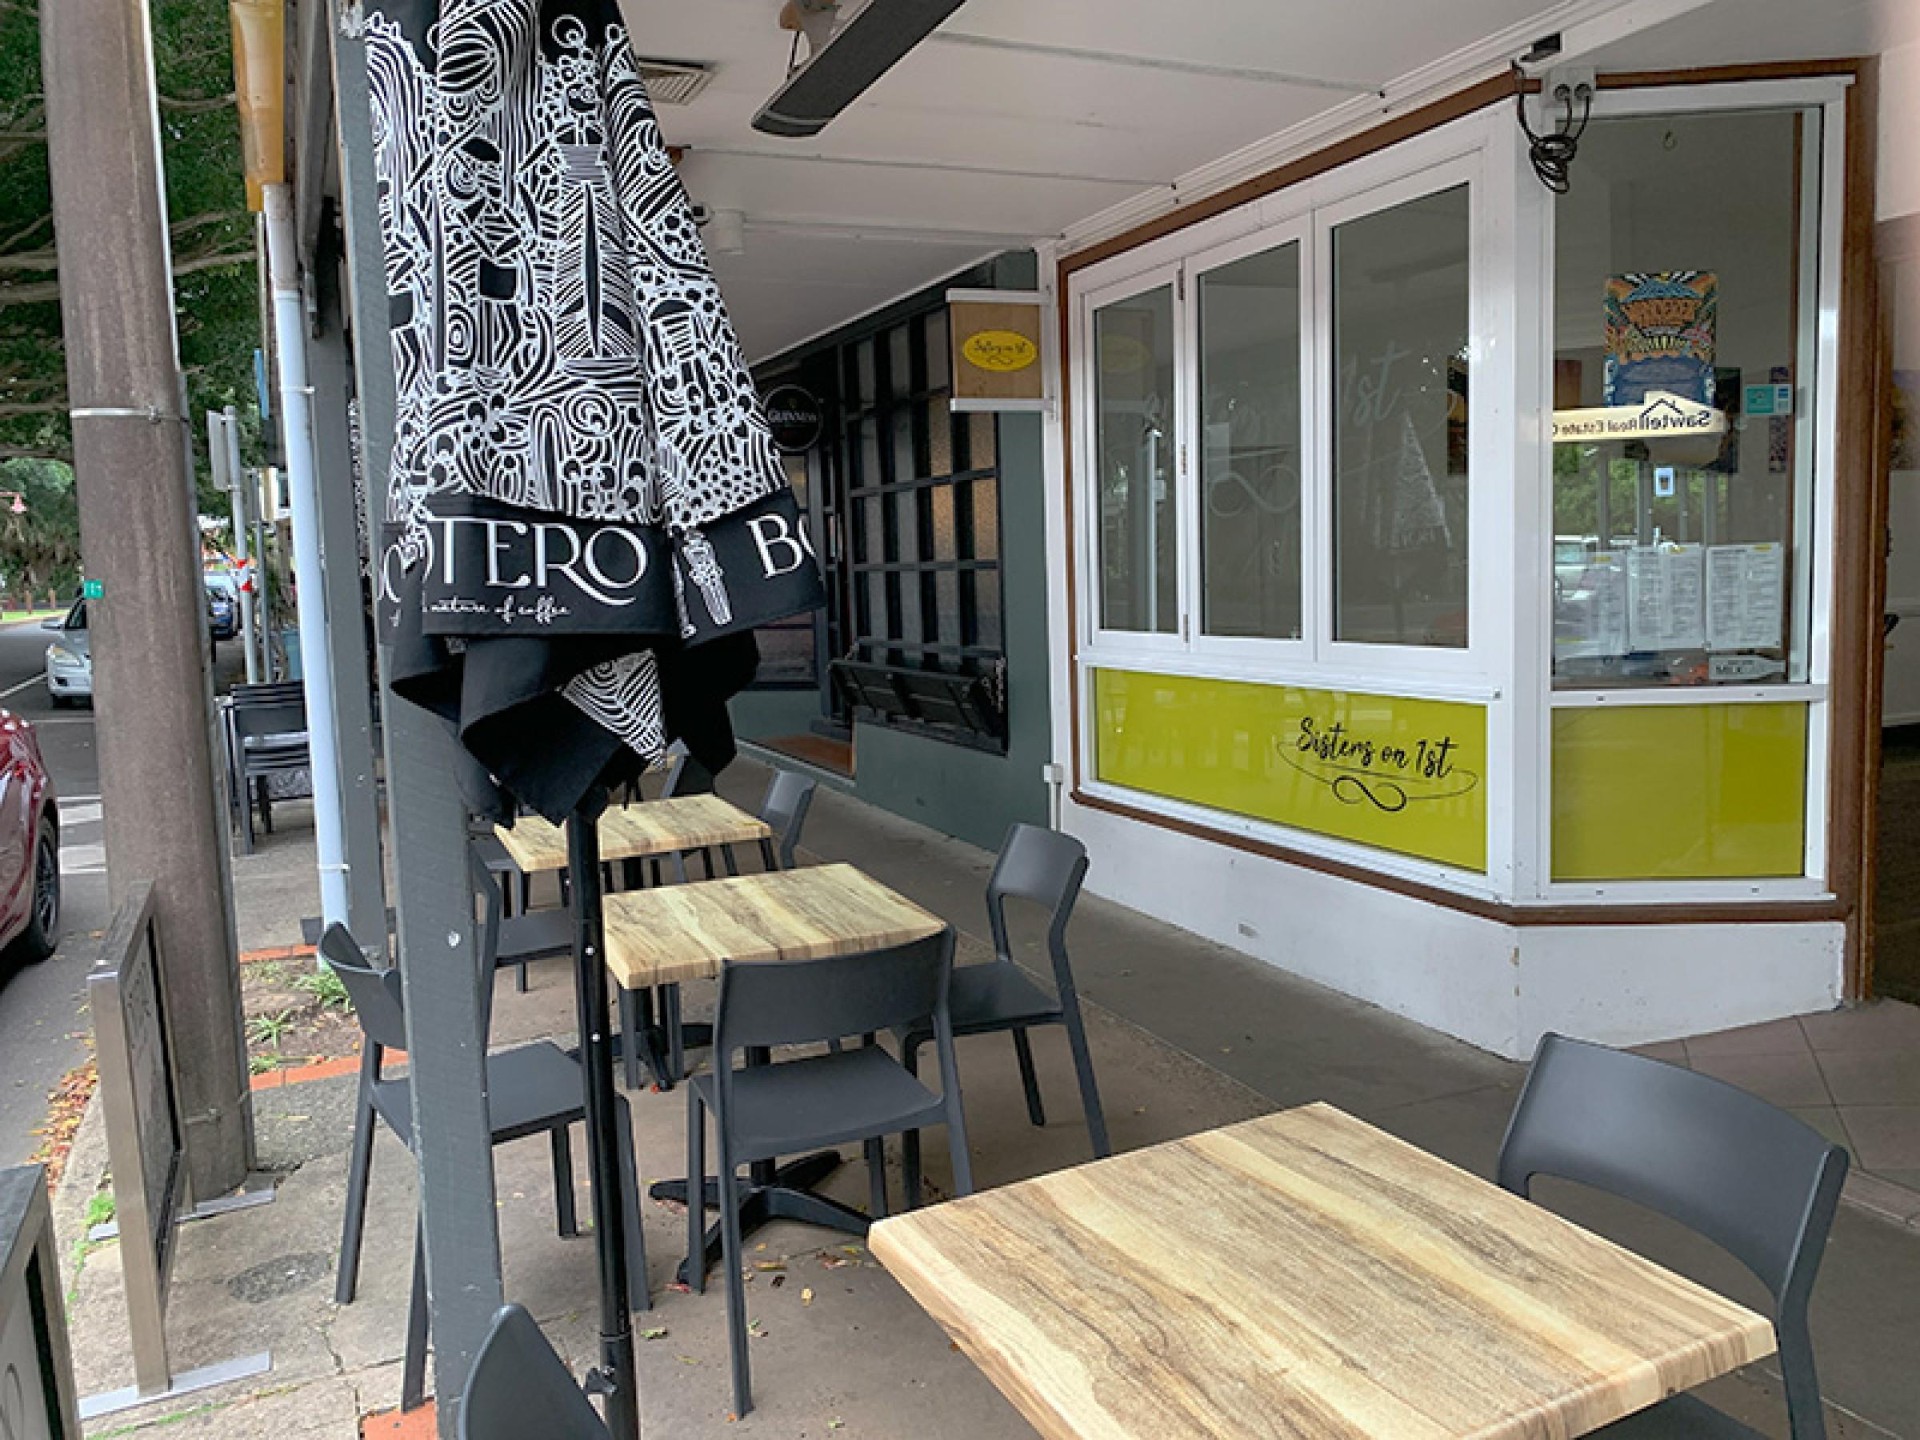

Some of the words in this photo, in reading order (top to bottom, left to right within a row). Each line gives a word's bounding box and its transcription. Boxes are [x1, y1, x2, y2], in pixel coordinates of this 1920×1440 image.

[1297, 716, 1375, 767] Sisters
[1380, 745, 1410, 769] on
[1415, 736, 1460, 779] 1st
